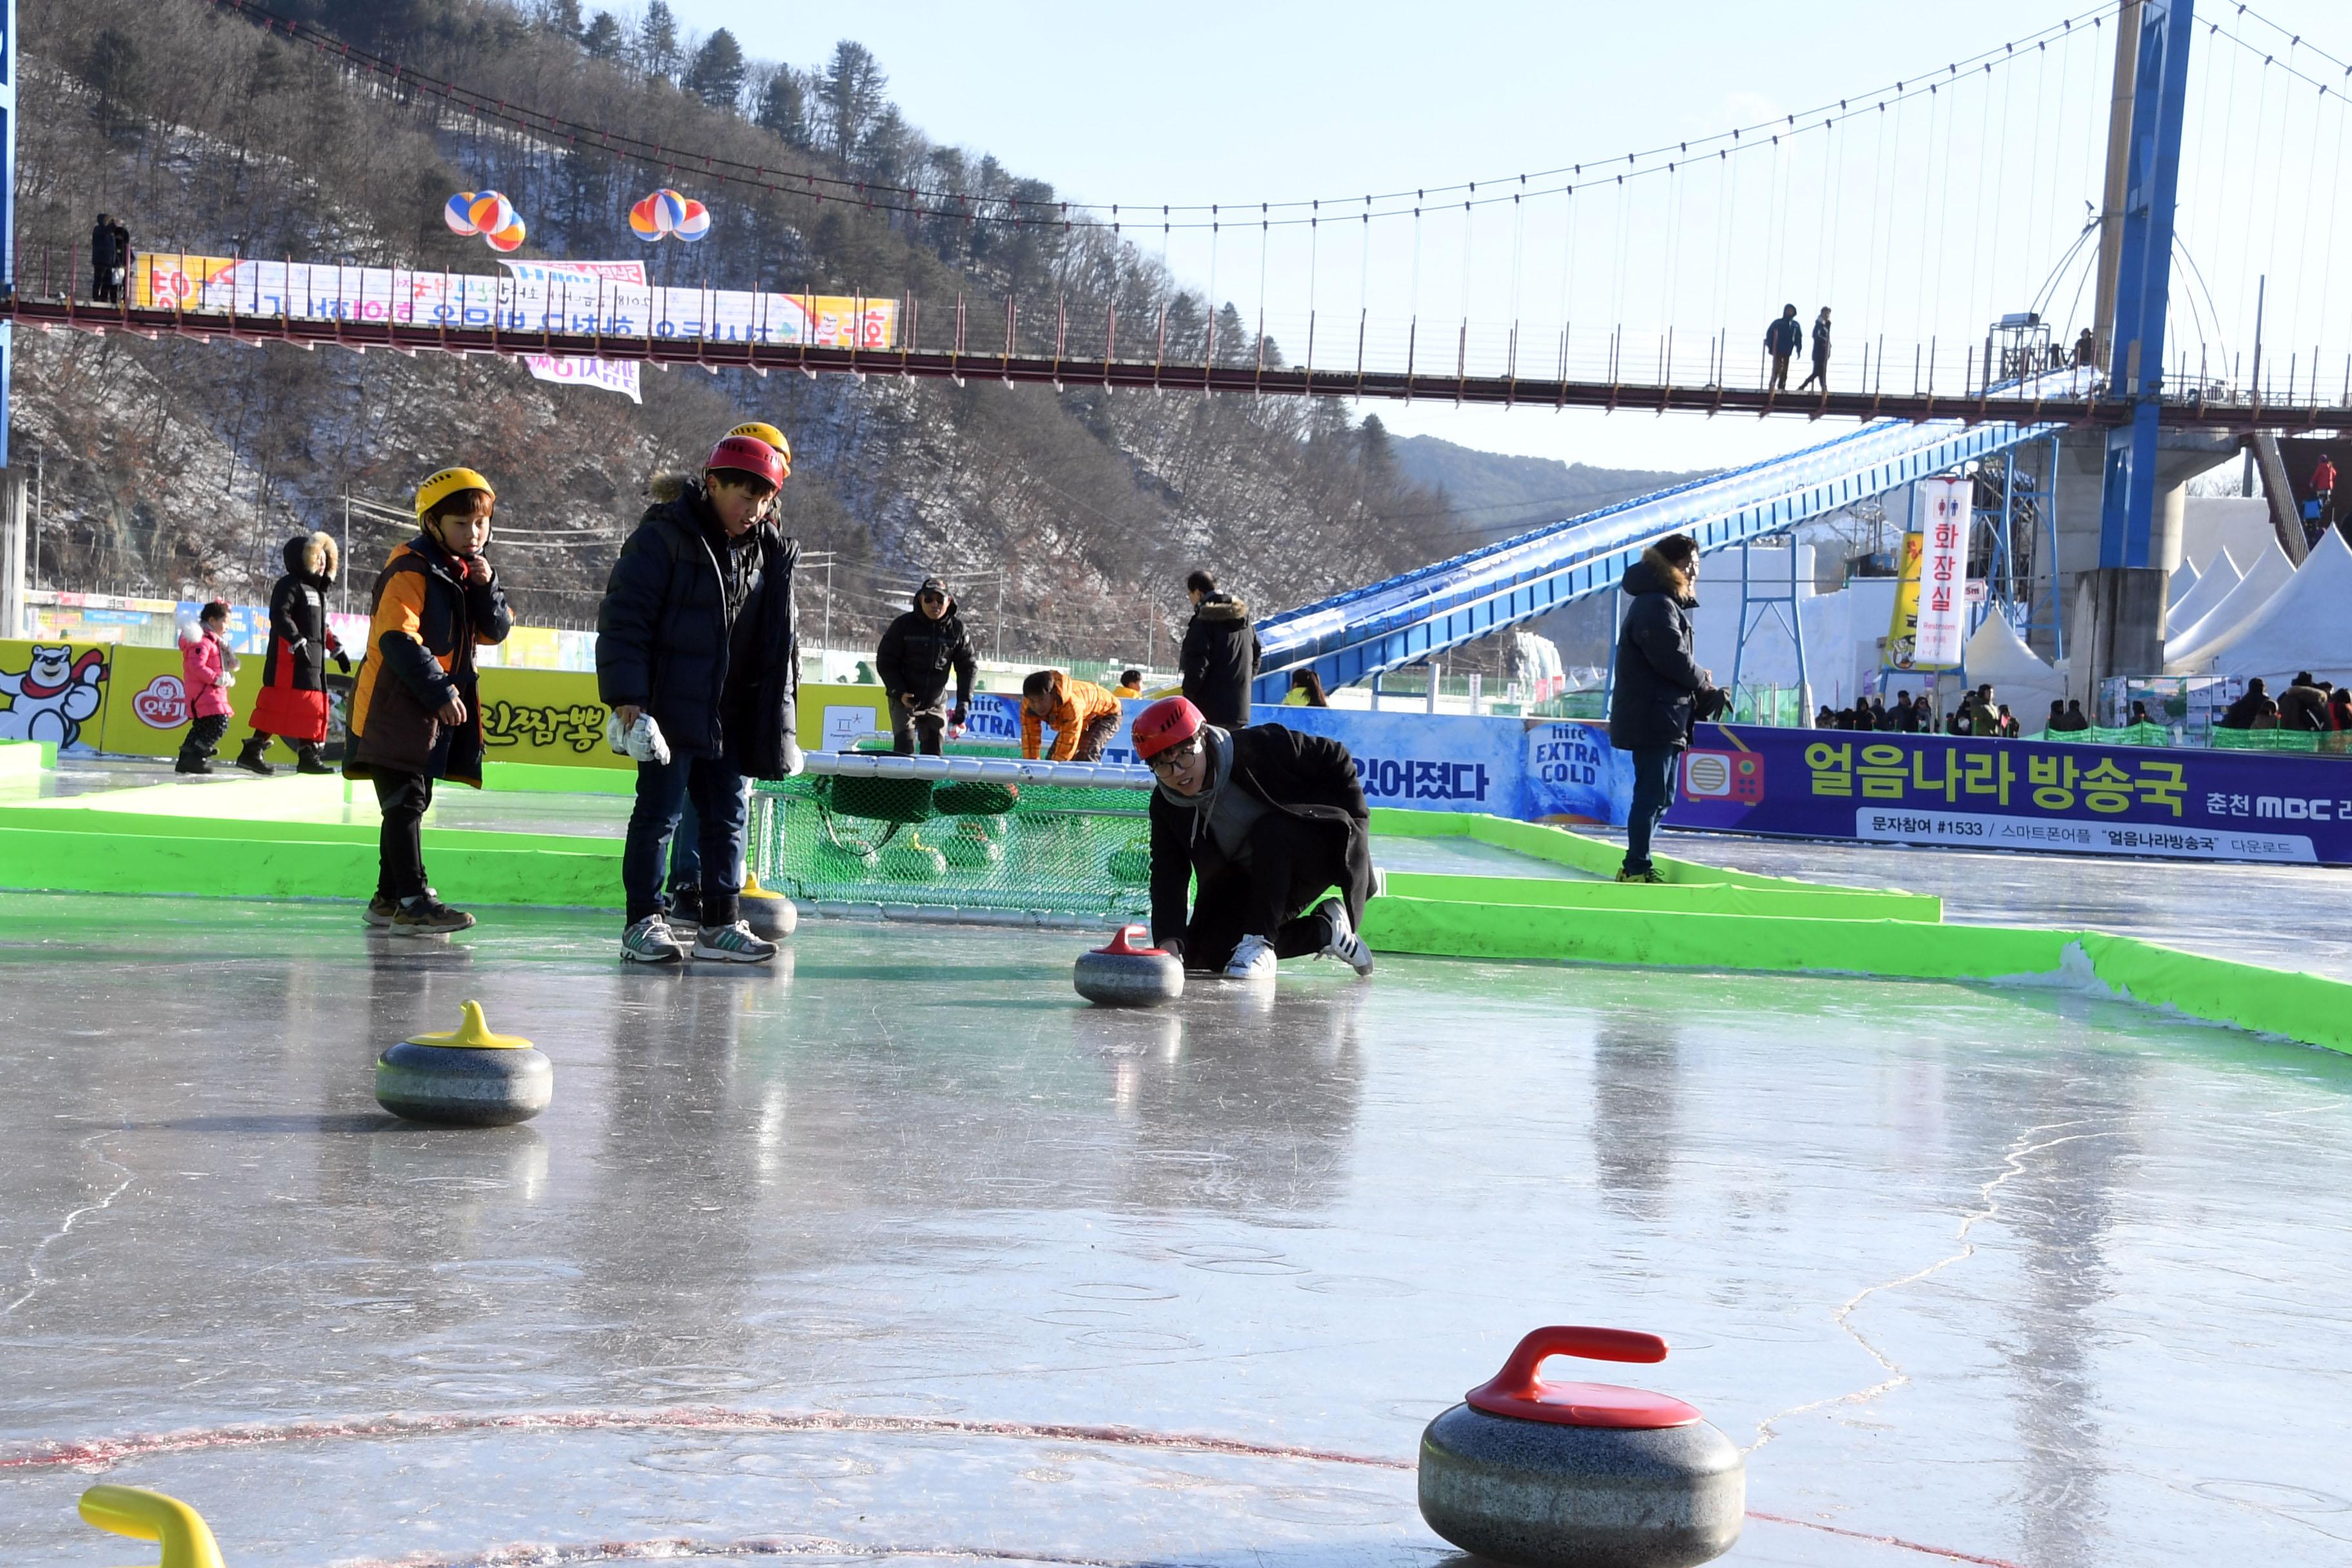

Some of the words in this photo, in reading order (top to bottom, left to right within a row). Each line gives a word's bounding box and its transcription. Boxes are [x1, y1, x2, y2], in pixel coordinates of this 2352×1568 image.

[1930, 523, 1959, 612] 화장실
[1923, 621, 1955, 630] Restroom
[144, 700, 186, 716] 오뚜기
[480, 699, 604, 753] 진짬뽕
[1553, 723, 1587, 741] hite
[1536, 741, 1601, 767] EXTRA
[1542, 763, 1596, 786] COLD
[1805, 741, 2015, 806] 얼음나라
[2028, 754, 2188, 818] 방송국
[2206, 792, 2249, 818] 춘천
[1872, 815, 1932, 834] 문자참여
[1937, 819, 1983, 836] #1533
[2000, 823, 2091, 844] 스마트폰어플
[2231, 839, 2294, 854] 다운로드
